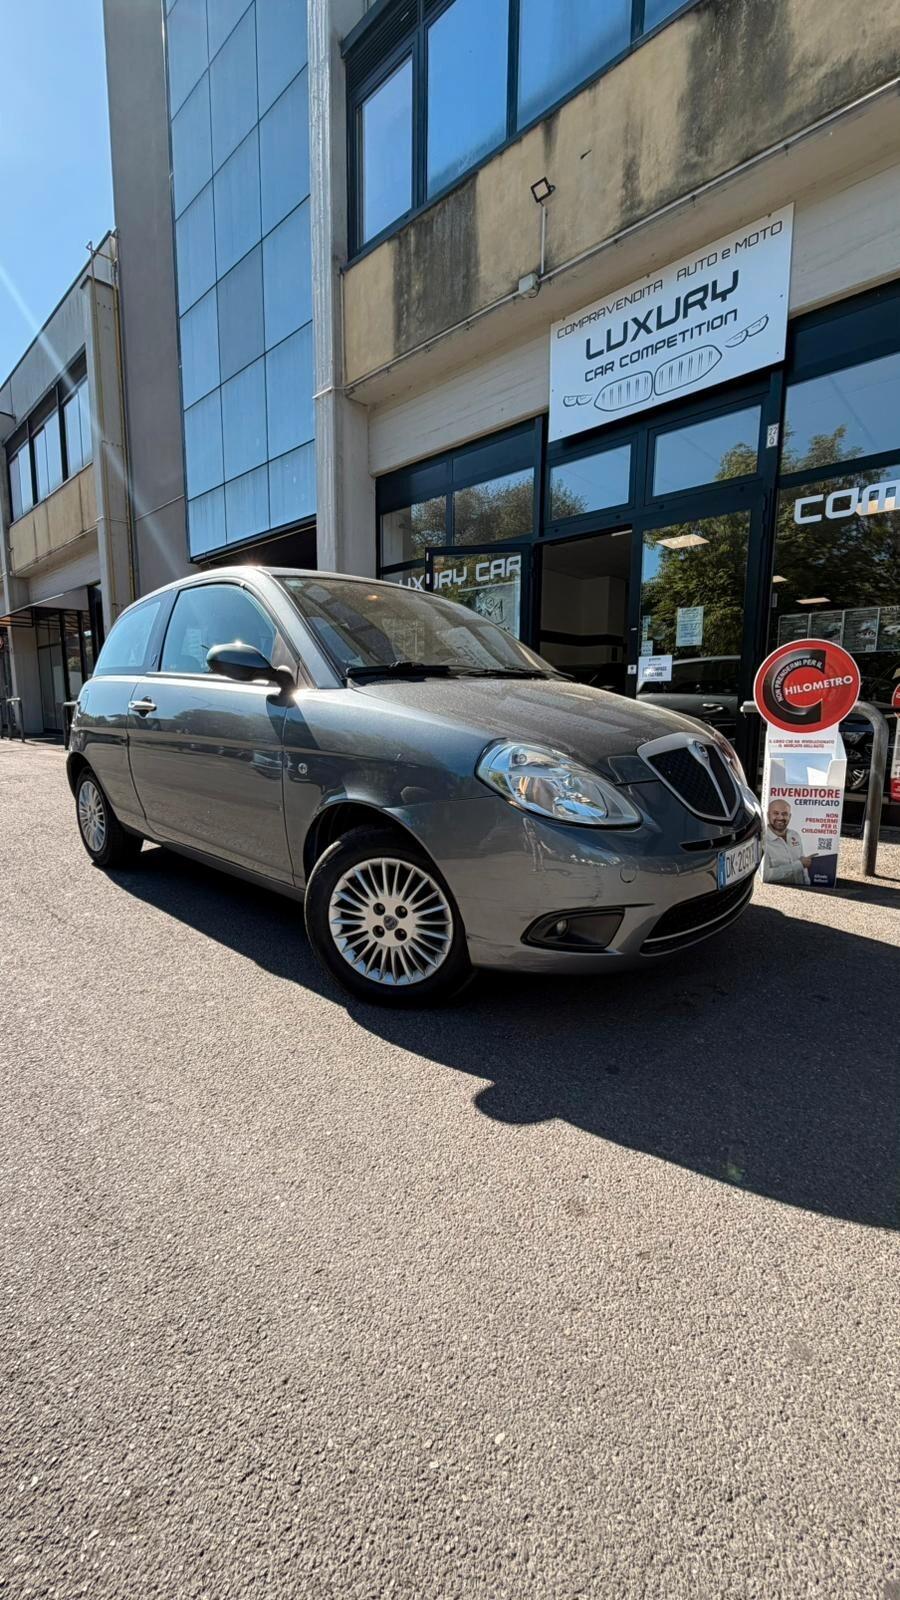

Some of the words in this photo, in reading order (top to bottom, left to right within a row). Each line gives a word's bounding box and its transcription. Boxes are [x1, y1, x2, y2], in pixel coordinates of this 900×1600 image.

[556, 279, 663, 340] COMPRAVENDITA
[676, 252, 718, 282] AUTO
[721, 247, 731, 260] e
[734, 220, 783, 254] MOTO
[585, 269, 739, 360] LUXURY
[584, 360, 614, 383] CAR
[618, 308, 738, 368] COMPETITION
[398, 566, 467, 592] UXURY
[475, 556, 521, 581] CAR
[770, 787, 841, 799] RIVENDITORE
[794, 799, 840, 807] CERTIFICATO
